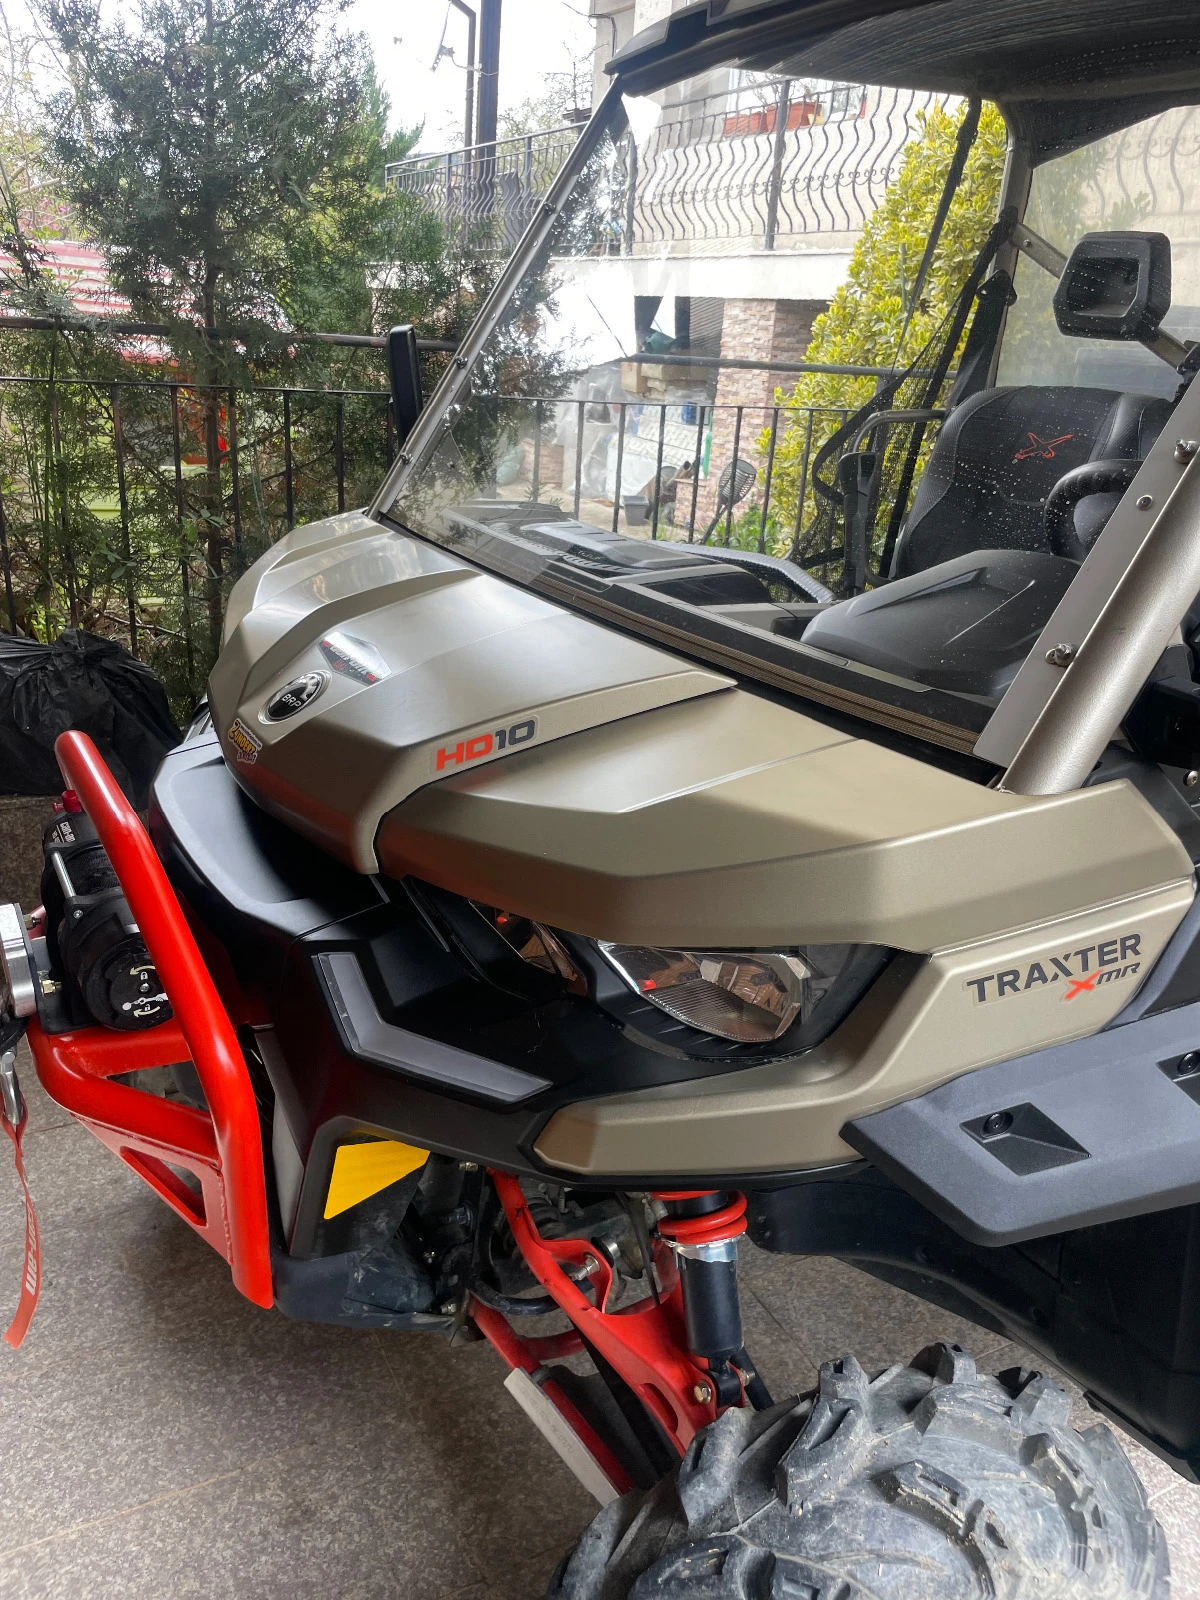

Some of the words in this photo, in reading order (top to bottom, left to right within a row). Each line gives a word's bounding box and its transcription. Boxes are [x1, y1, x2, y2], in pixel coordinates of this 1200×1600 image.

[282, 693, 302, 707] BRP
[436, 719, 536, 771] HD10
[966, 933, 1141, 1003] TRAXTER
